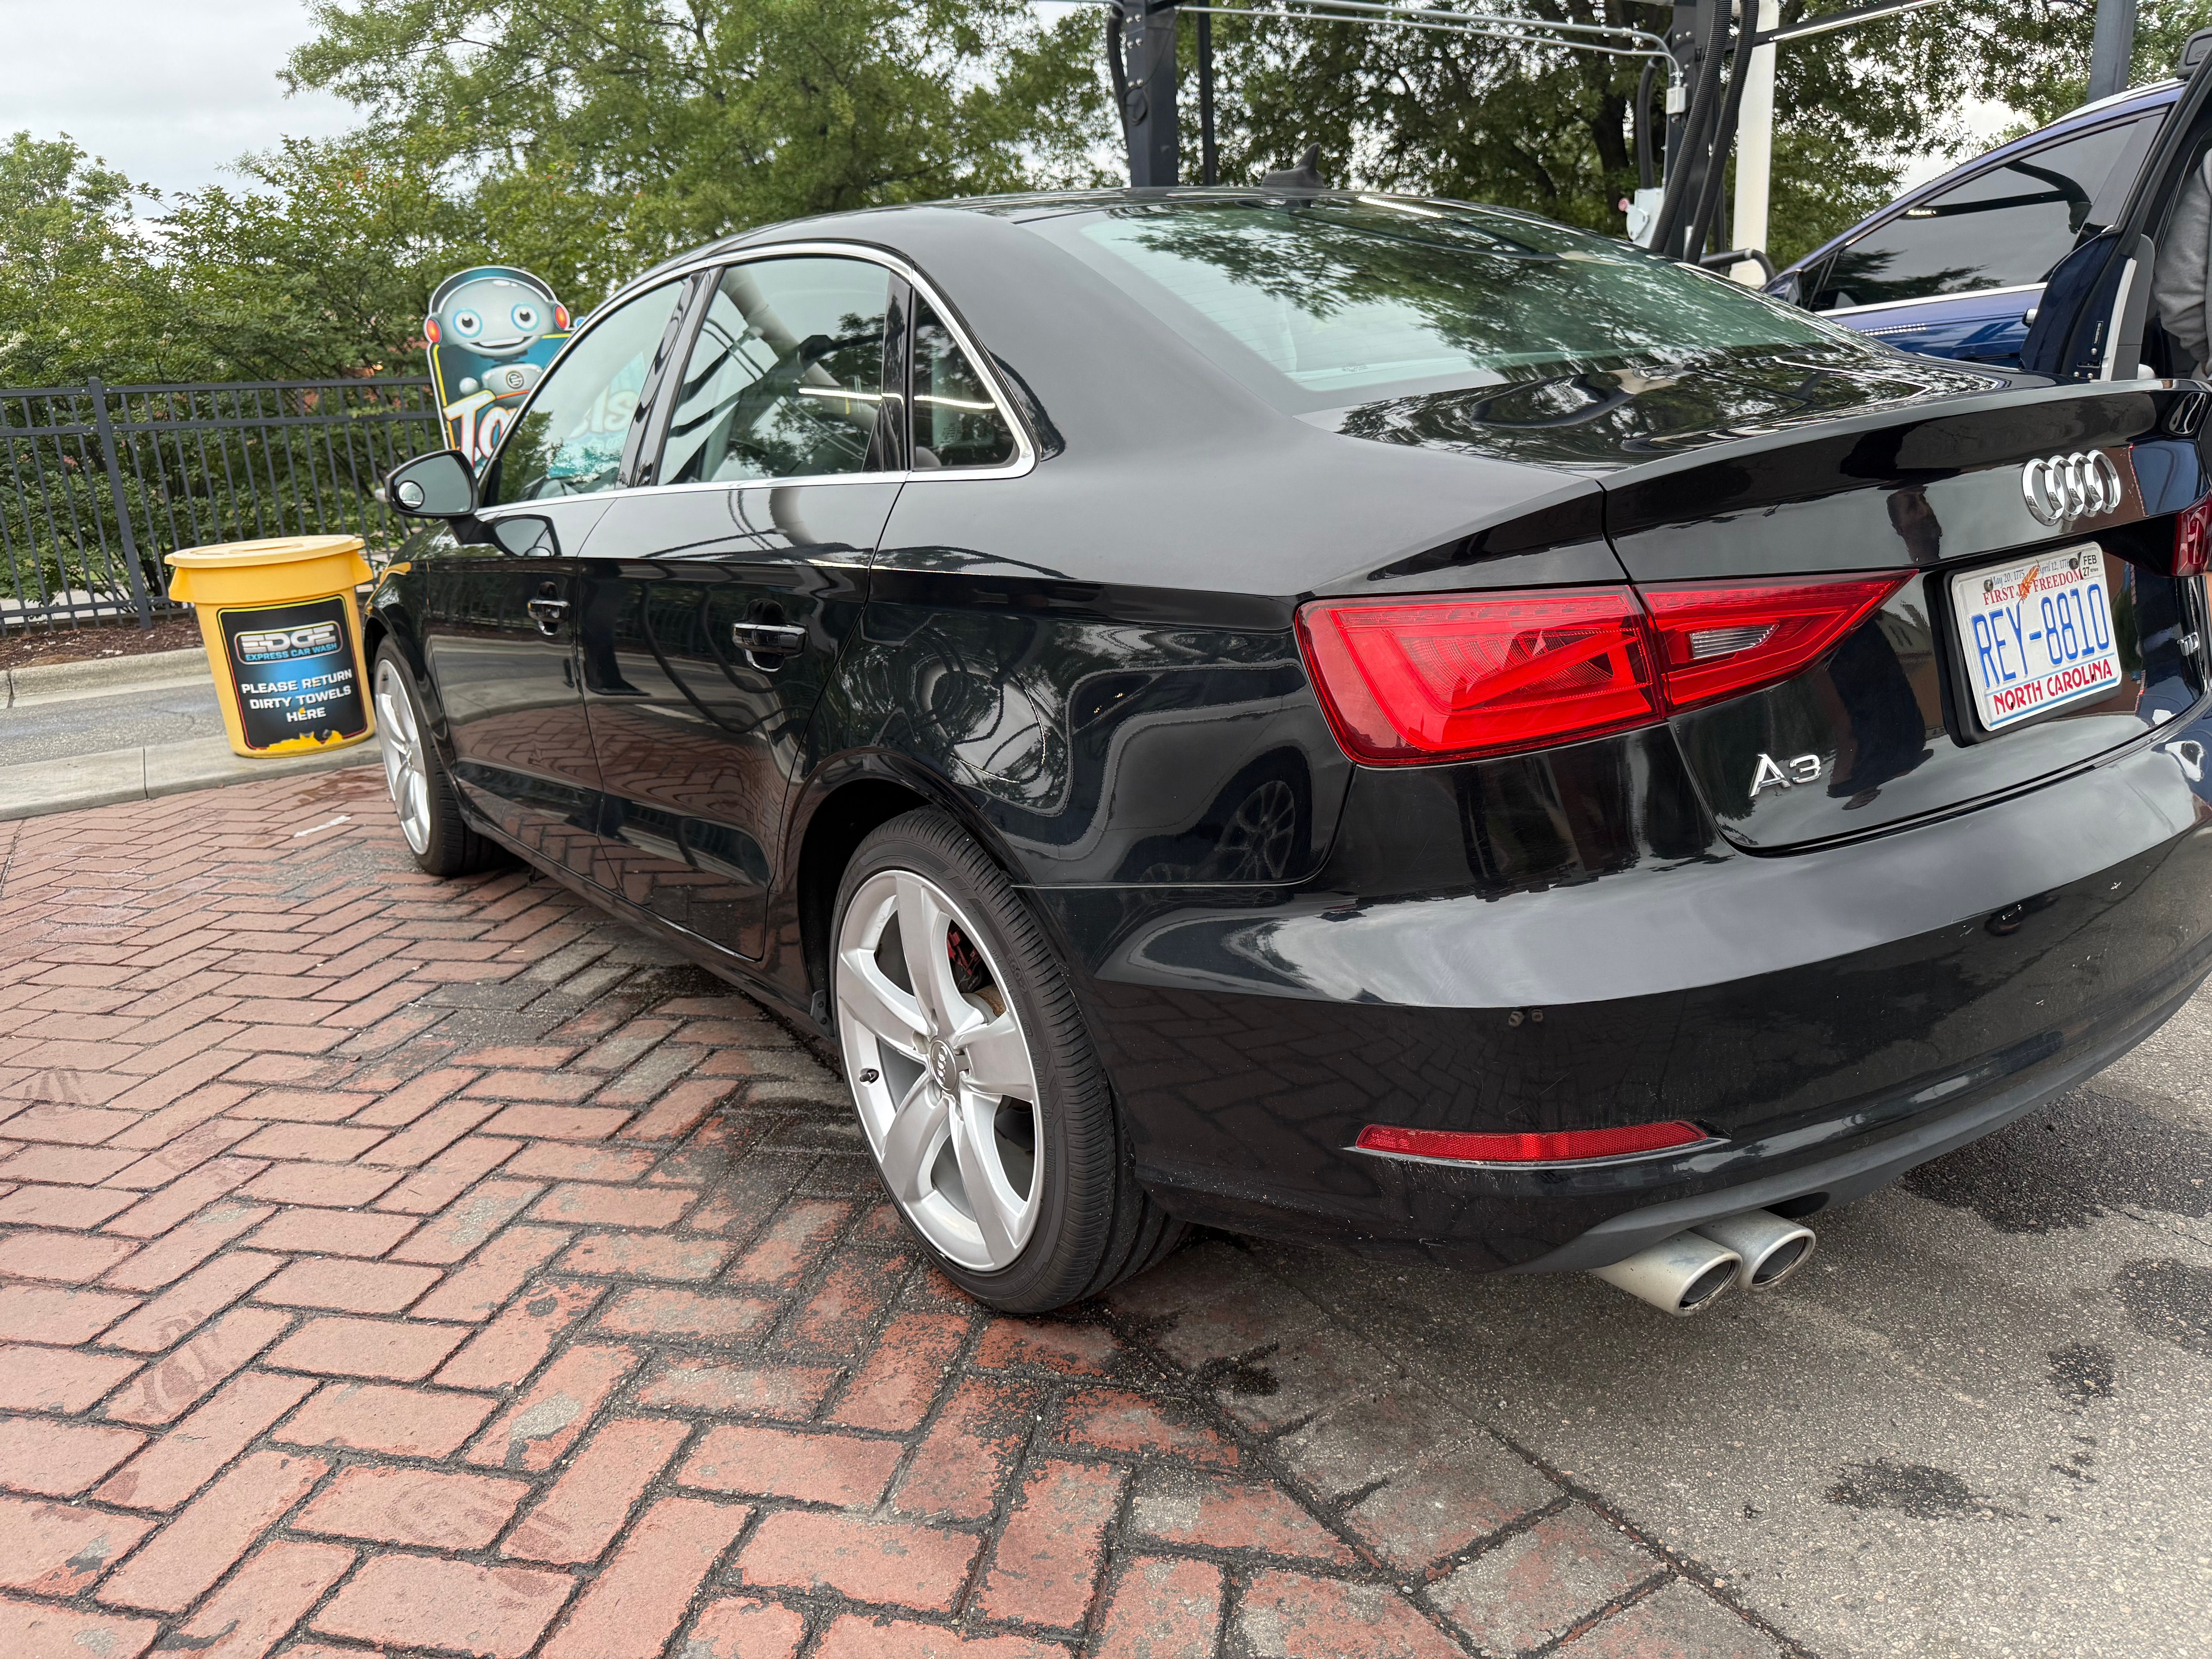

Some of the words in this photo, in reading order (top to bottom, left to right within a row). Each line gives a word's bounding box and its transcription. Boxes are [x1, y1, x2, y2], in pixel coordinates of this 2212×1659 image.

[2083, 555, 2097, 565] FEB
[2083, 567, 2089, 576] 27
[1982, 586, 2014, 605] FIRST
[2033, 568, 2084, 592] FREEDOM
[2004, 573, 2013, 582] 20,
[241, 624, 336, 654] EDGE
[1972, 584, 2109, 688] REY-8810
[245, 651, 289, 661] EXPRESS
[290, 647, 311, 657] CAR
[312, 643, 337, 654] WASH
[241, 680, 298, 694] PLEASE
[302, 668, 352, 689] RETURN
[1993, 680, 2044, 715] NORTH
[2047, 659, 2112, 697] CAROLINA
[249, 697, 292, 709] DIRTY
[296, 685, 351, 705] TOWELS
[286, 707, 326, 722] HERE
[1748, 754, 1821, 797] A3
